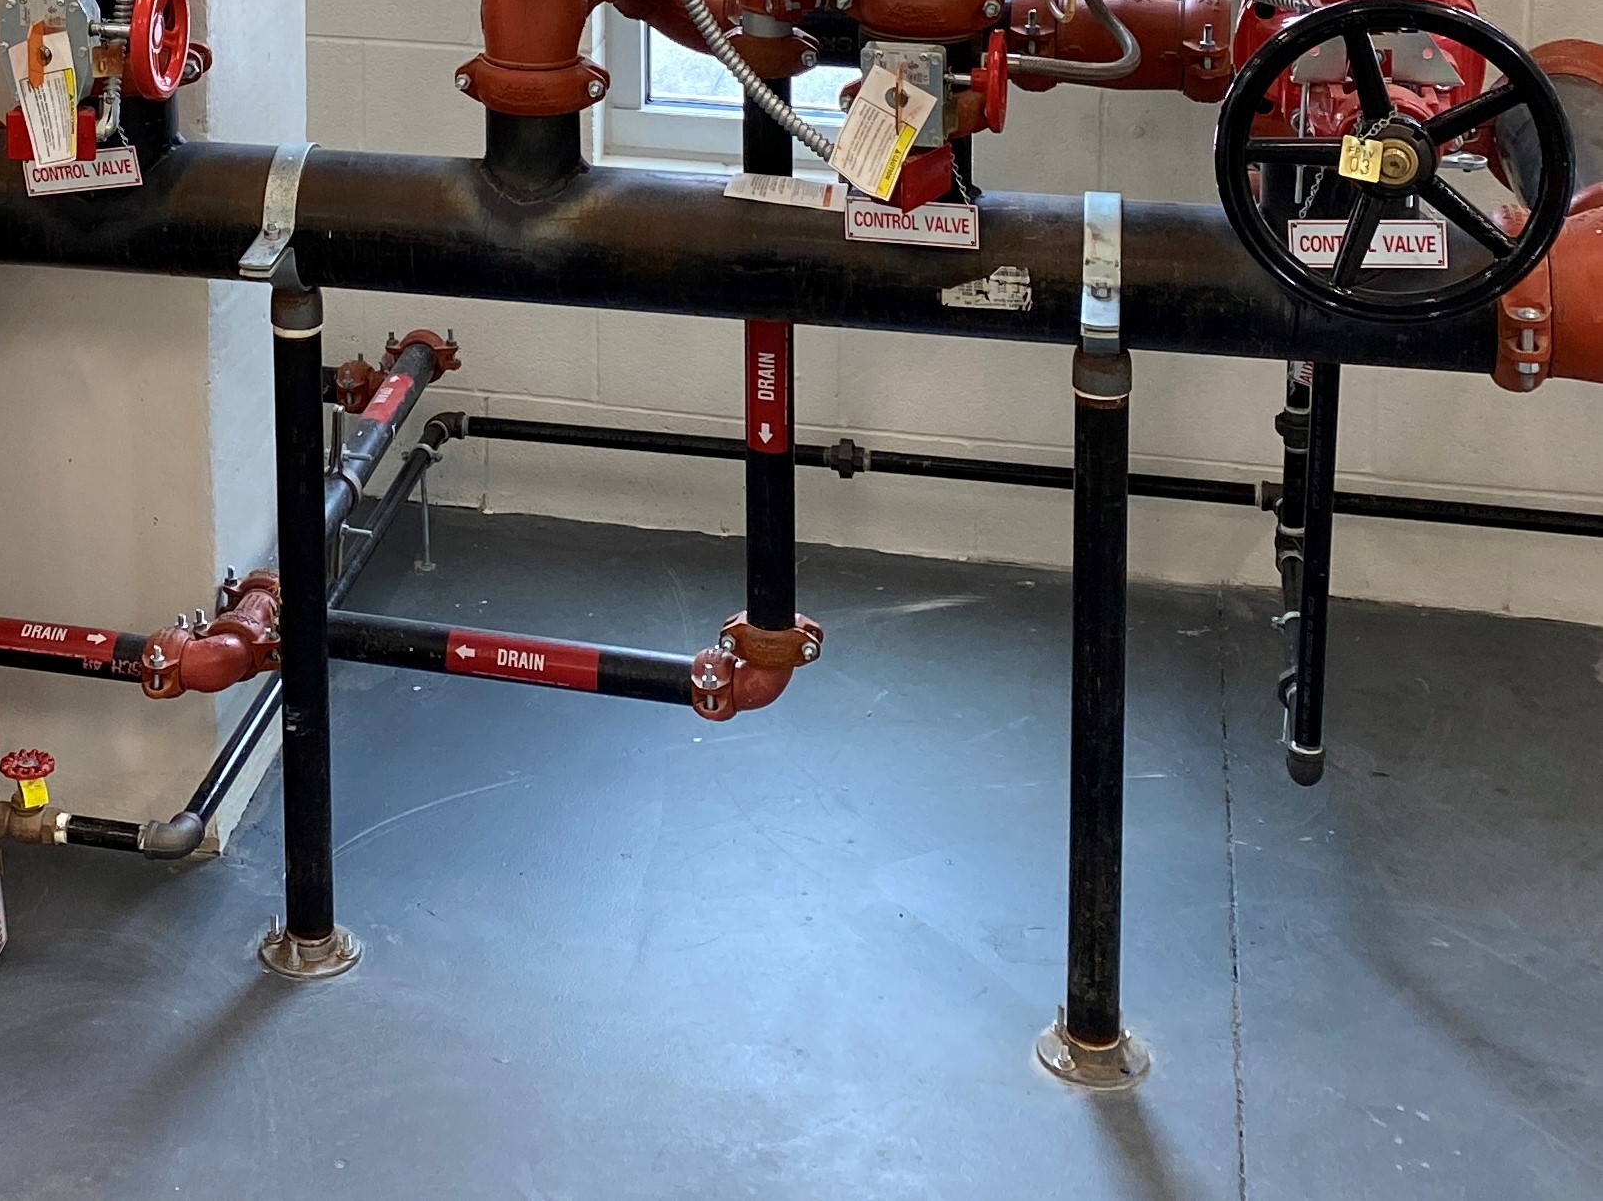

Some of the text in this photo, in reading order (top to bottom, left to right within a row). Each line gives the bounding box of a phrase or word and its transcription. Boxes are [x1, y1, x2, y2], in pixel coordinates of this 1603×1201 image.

[32, 158, 133, 183] CONTROL VALVE
[853, 210, 970, 236] CONTROL VALVE
[1299, 235, 1437, 253] CONTL VALVE
[757, 352, 776, 402] DRAIN
[20, 623, 68, 642] DRAIN
[497, 648, 545, 672] DRAIN
